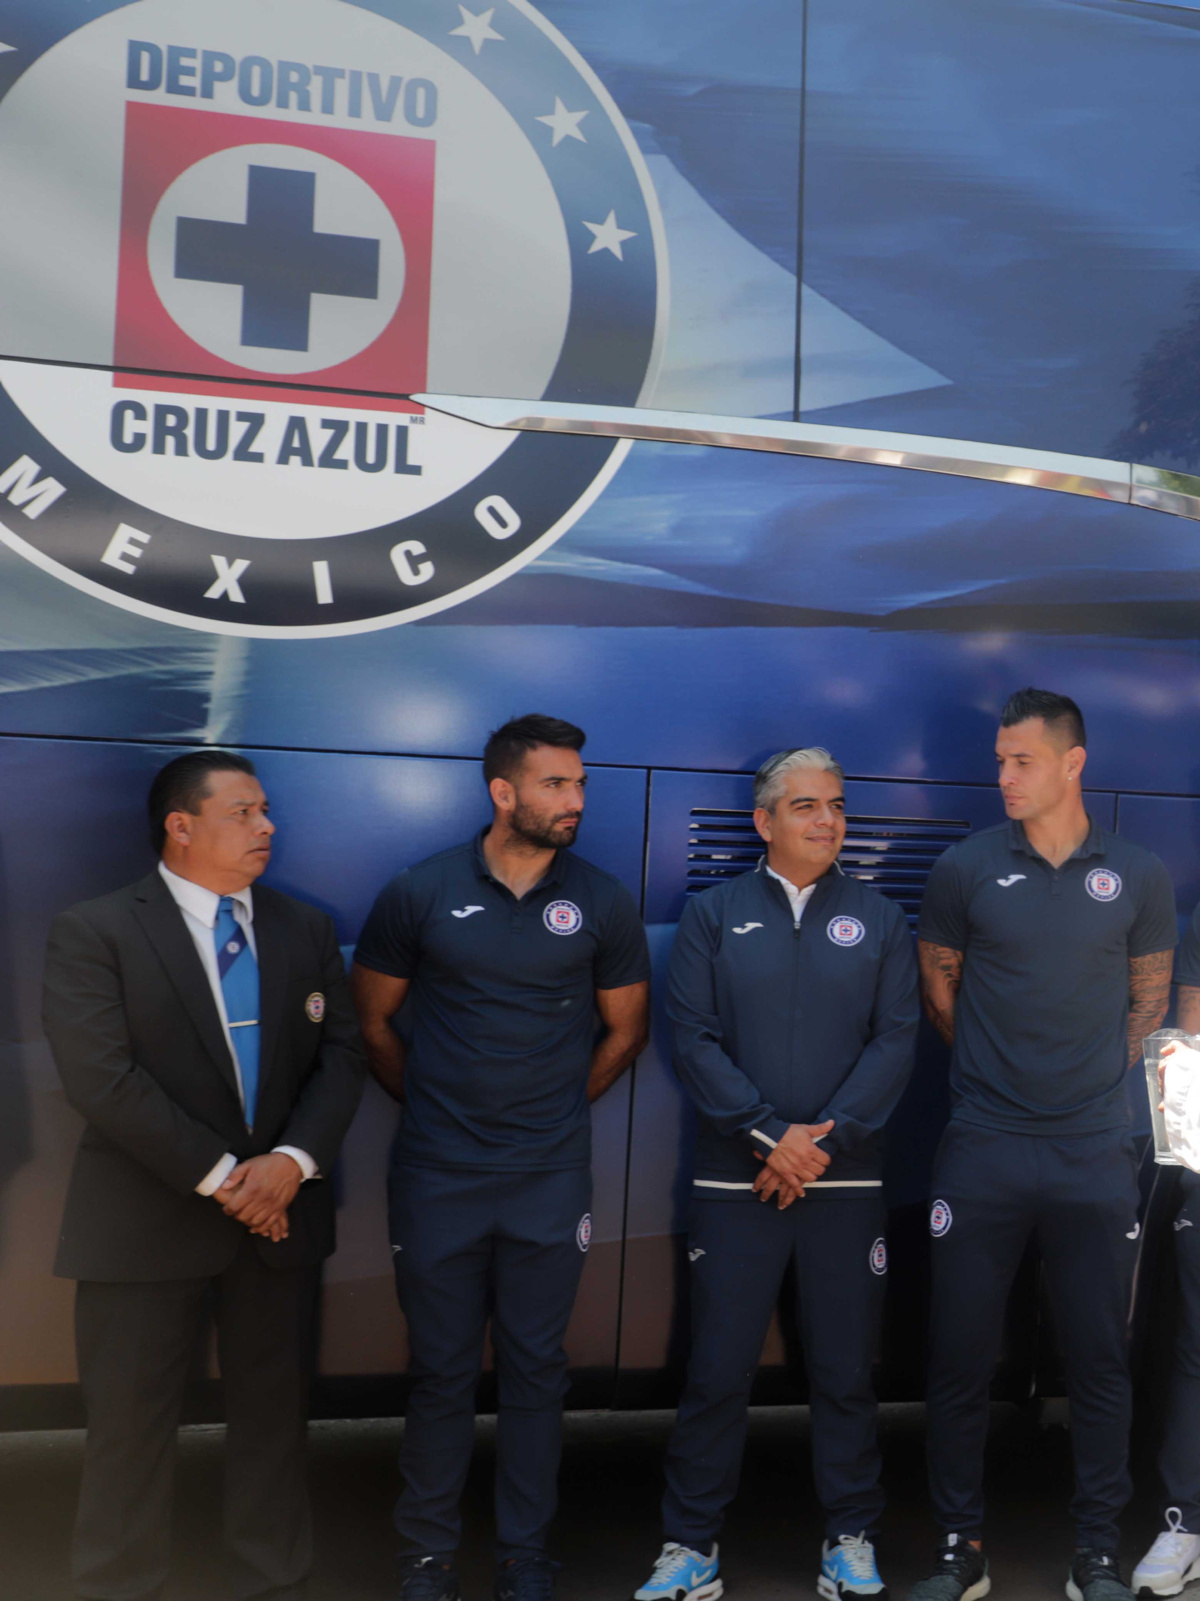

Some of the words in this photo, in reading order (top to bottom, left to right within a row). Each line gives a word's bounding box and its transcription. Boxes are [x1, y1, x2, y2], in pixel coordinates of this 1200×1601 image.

[126, 39, 438, 128] DEPORTIVO
[109, 400, 266, 464] CRUZ
[276, 414, 423, 476] AZUL
[0, 454, 521, 604] MEXICO
